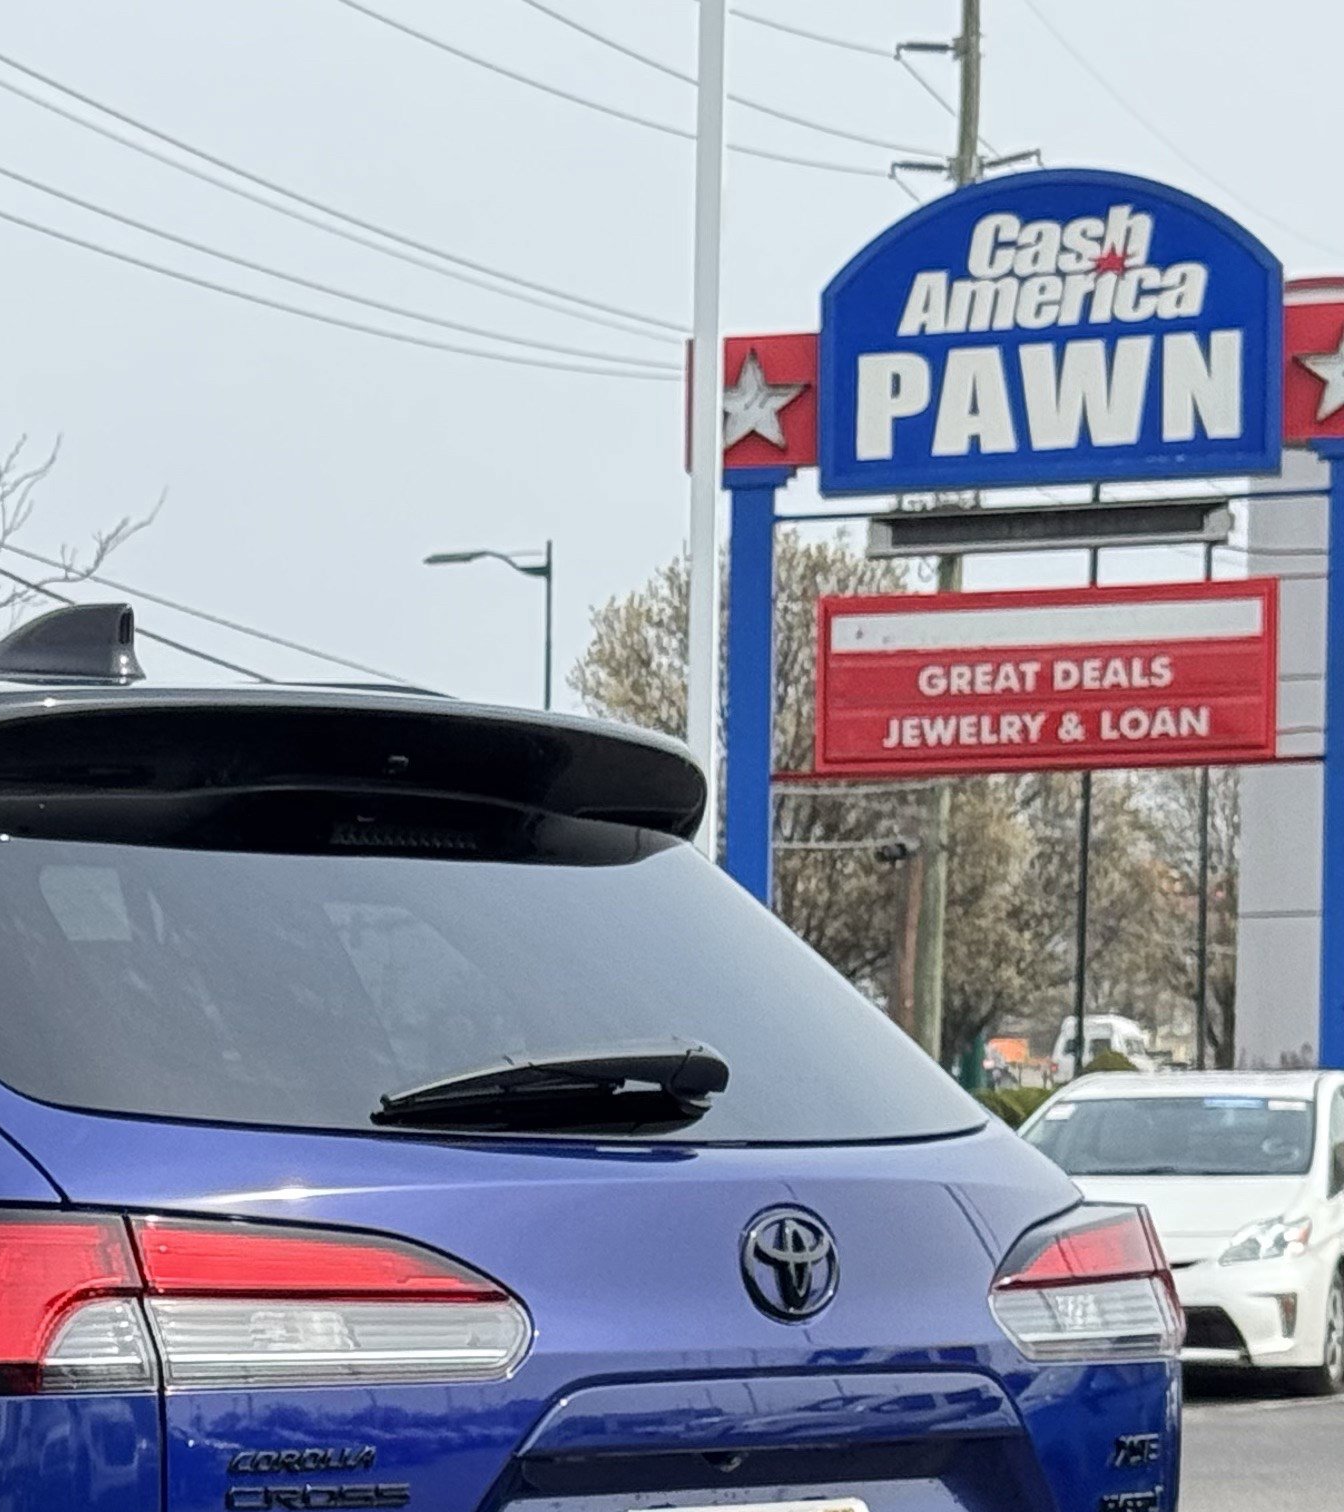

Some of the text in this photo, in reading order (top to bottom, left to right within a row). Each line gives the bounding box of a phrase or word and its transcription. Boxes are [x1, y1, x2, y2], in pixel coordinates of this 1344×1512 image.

[967, 203, 1154, 280] Cash
[896, 261, 1209, 338] America
[855, 328, 1245, 462] PAWN
[917, 655, 1175, 697] GREAT DEALS
[882, 705, 1211, 749] JEWELRY & LOAN
[225, 1446, 377, 1475] COROLLA
[224, 1482, 412, 1512] CROSS
